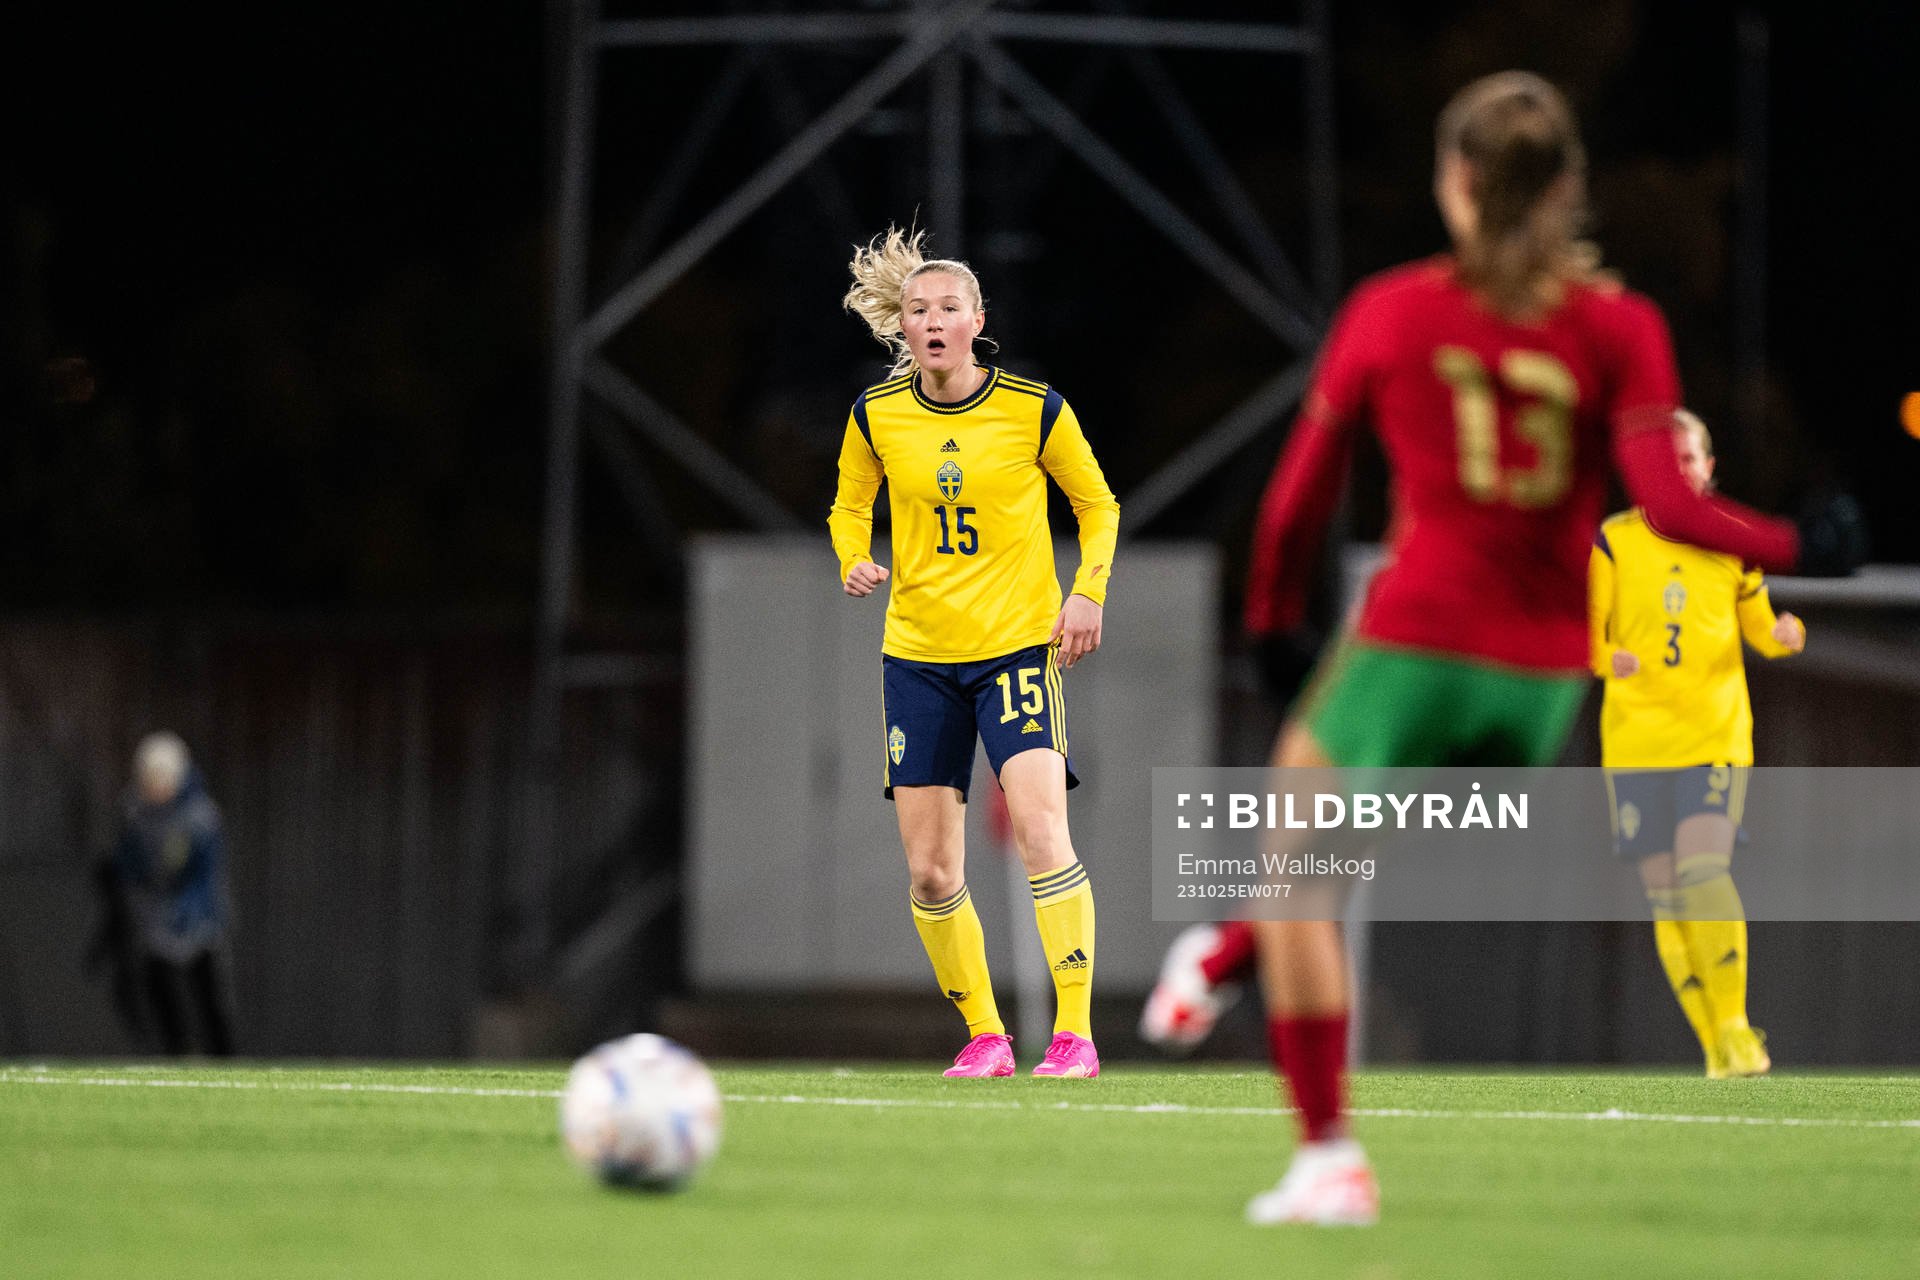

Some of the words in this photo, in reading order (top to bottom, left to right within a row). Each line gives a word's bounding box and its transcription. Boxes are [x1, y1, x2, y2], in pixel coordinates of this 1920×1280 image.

[1432, 345, 1579, 508] 13
[934, 505, 979, 556] 15
[1663, 623, 1681, 668] 3
[996, 667, 1044, 725] 15
[1054, 961, 1089, 971] adida
